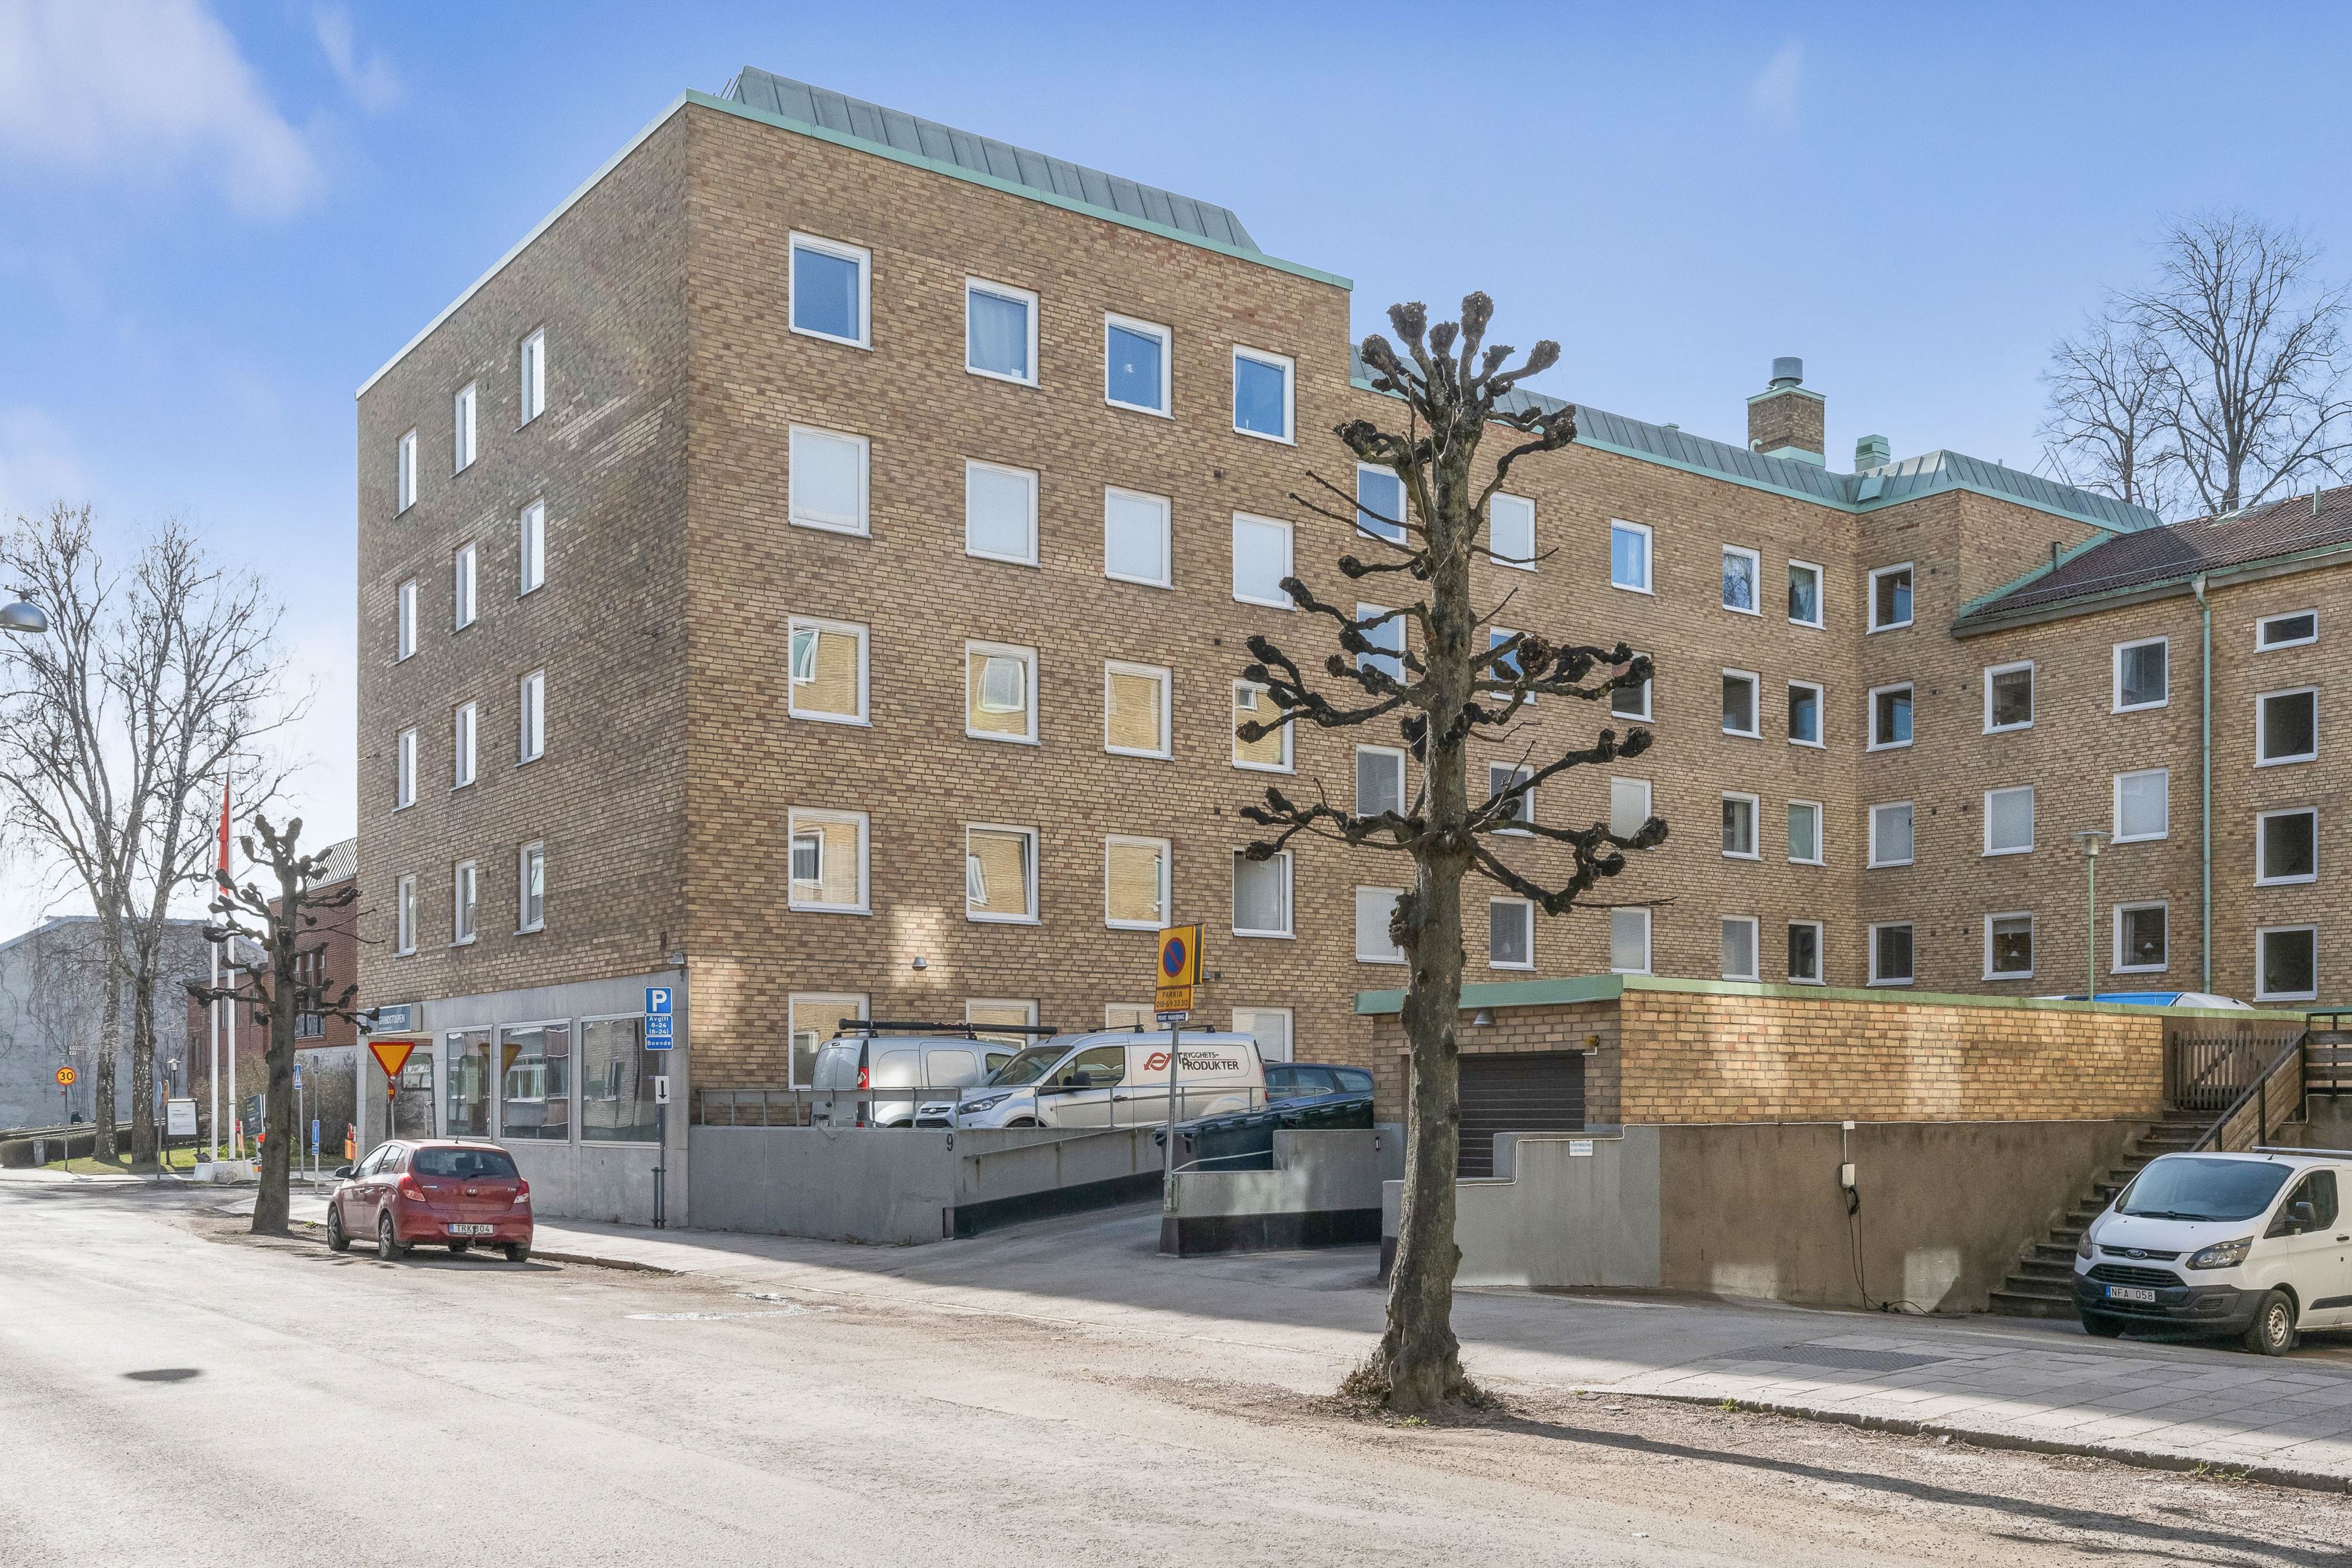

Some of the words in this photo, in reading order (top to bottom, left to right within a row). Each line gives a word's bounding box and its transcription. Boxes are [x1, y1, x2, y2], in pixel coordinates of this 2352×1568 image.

[1162, 990, 1183, 999] PARKIA
[652, 990, 667, 1012] P
[379, 1013, 405, 1025] GRINDSTOLPEN
[1181, 1058, 1239, 1071] PRODUKTER
[60, 1071, 73, 1081] 30
[947, 1133, 953, 1151] 9
[2112, 1288, 2128, 1298] NFA
[2136, 1290, 2153, 1300] 058
